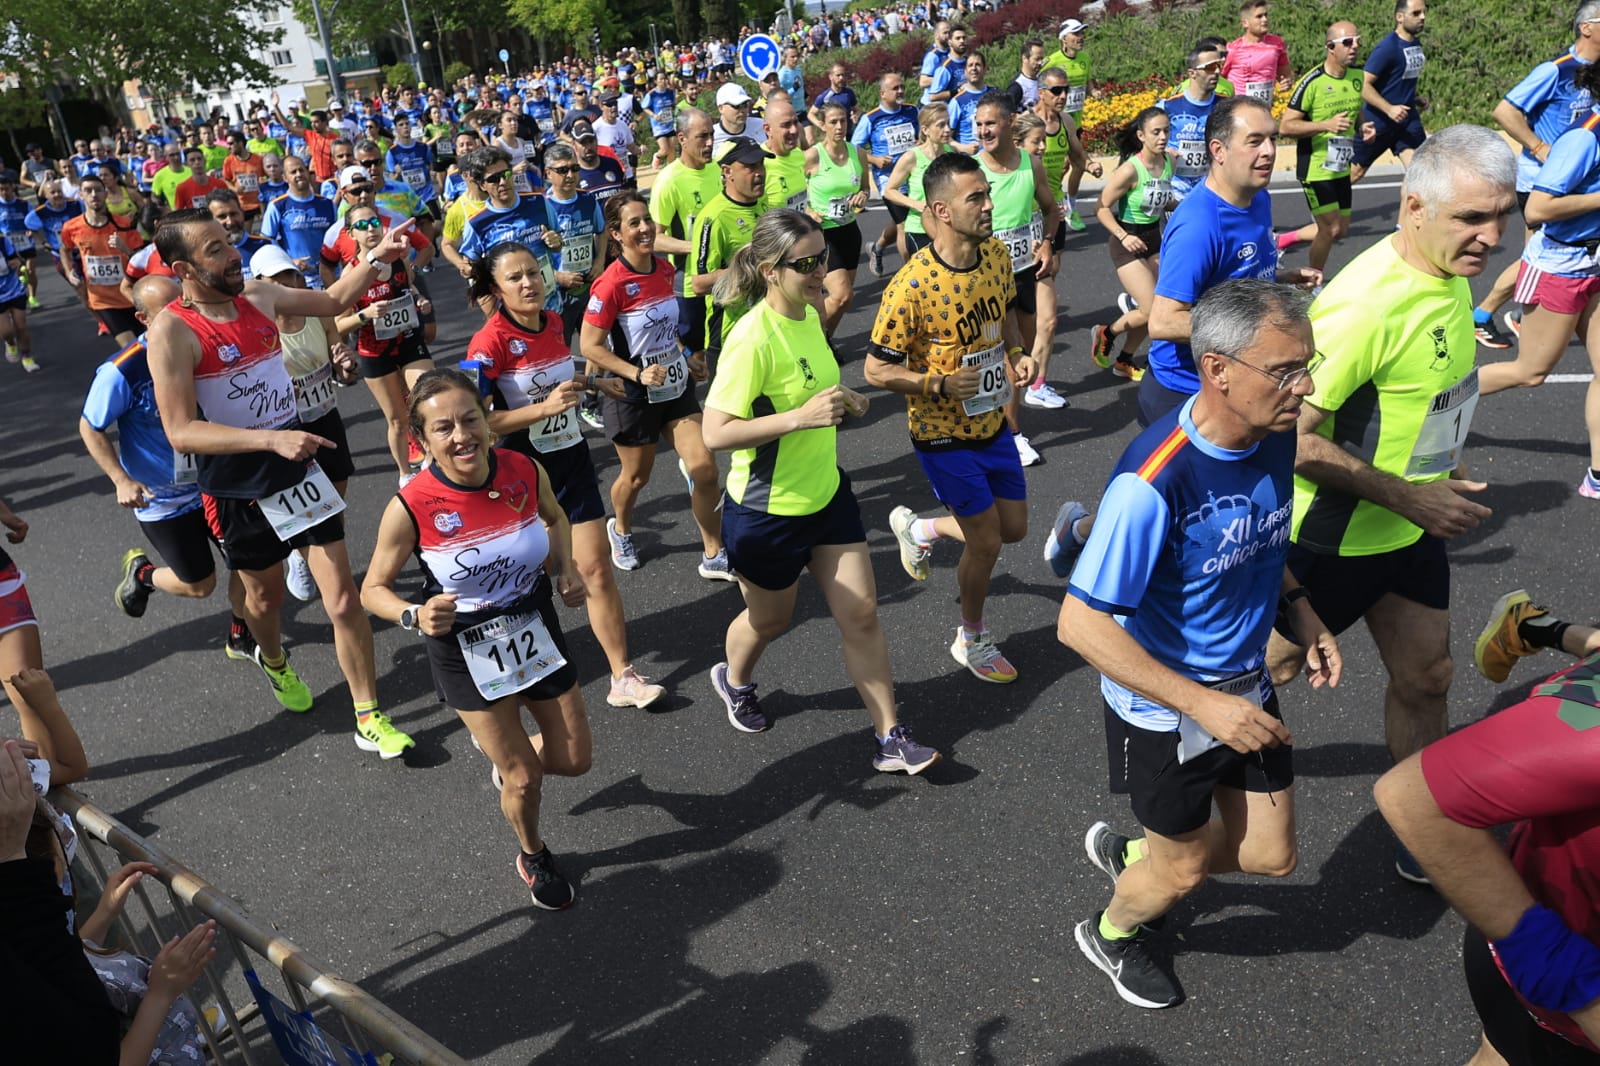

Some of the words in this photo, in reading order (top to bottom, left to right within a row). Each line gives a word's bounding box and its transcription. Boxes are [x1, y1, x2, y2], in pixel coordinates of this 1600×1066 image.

[890, 131, 914, 146] 1452
[566, 245, 590, 262] 1328
[91, 264, 121, 277] 1654
[383, 308, 410, 328] 820
[956, 295, 1002, 347] COMO
[227, 372, 269, 400] Simón
[1432, 391, 1451, 412] XII
[541, 413, 568, 436] 225
[1453, 408, 1462, 444] 1
[278, 481, 321, 515] 110
[1217, 513, 1252, 552] XII
[449, 547, 516, 581] Simón
[488, 629, 539, 673] 112
